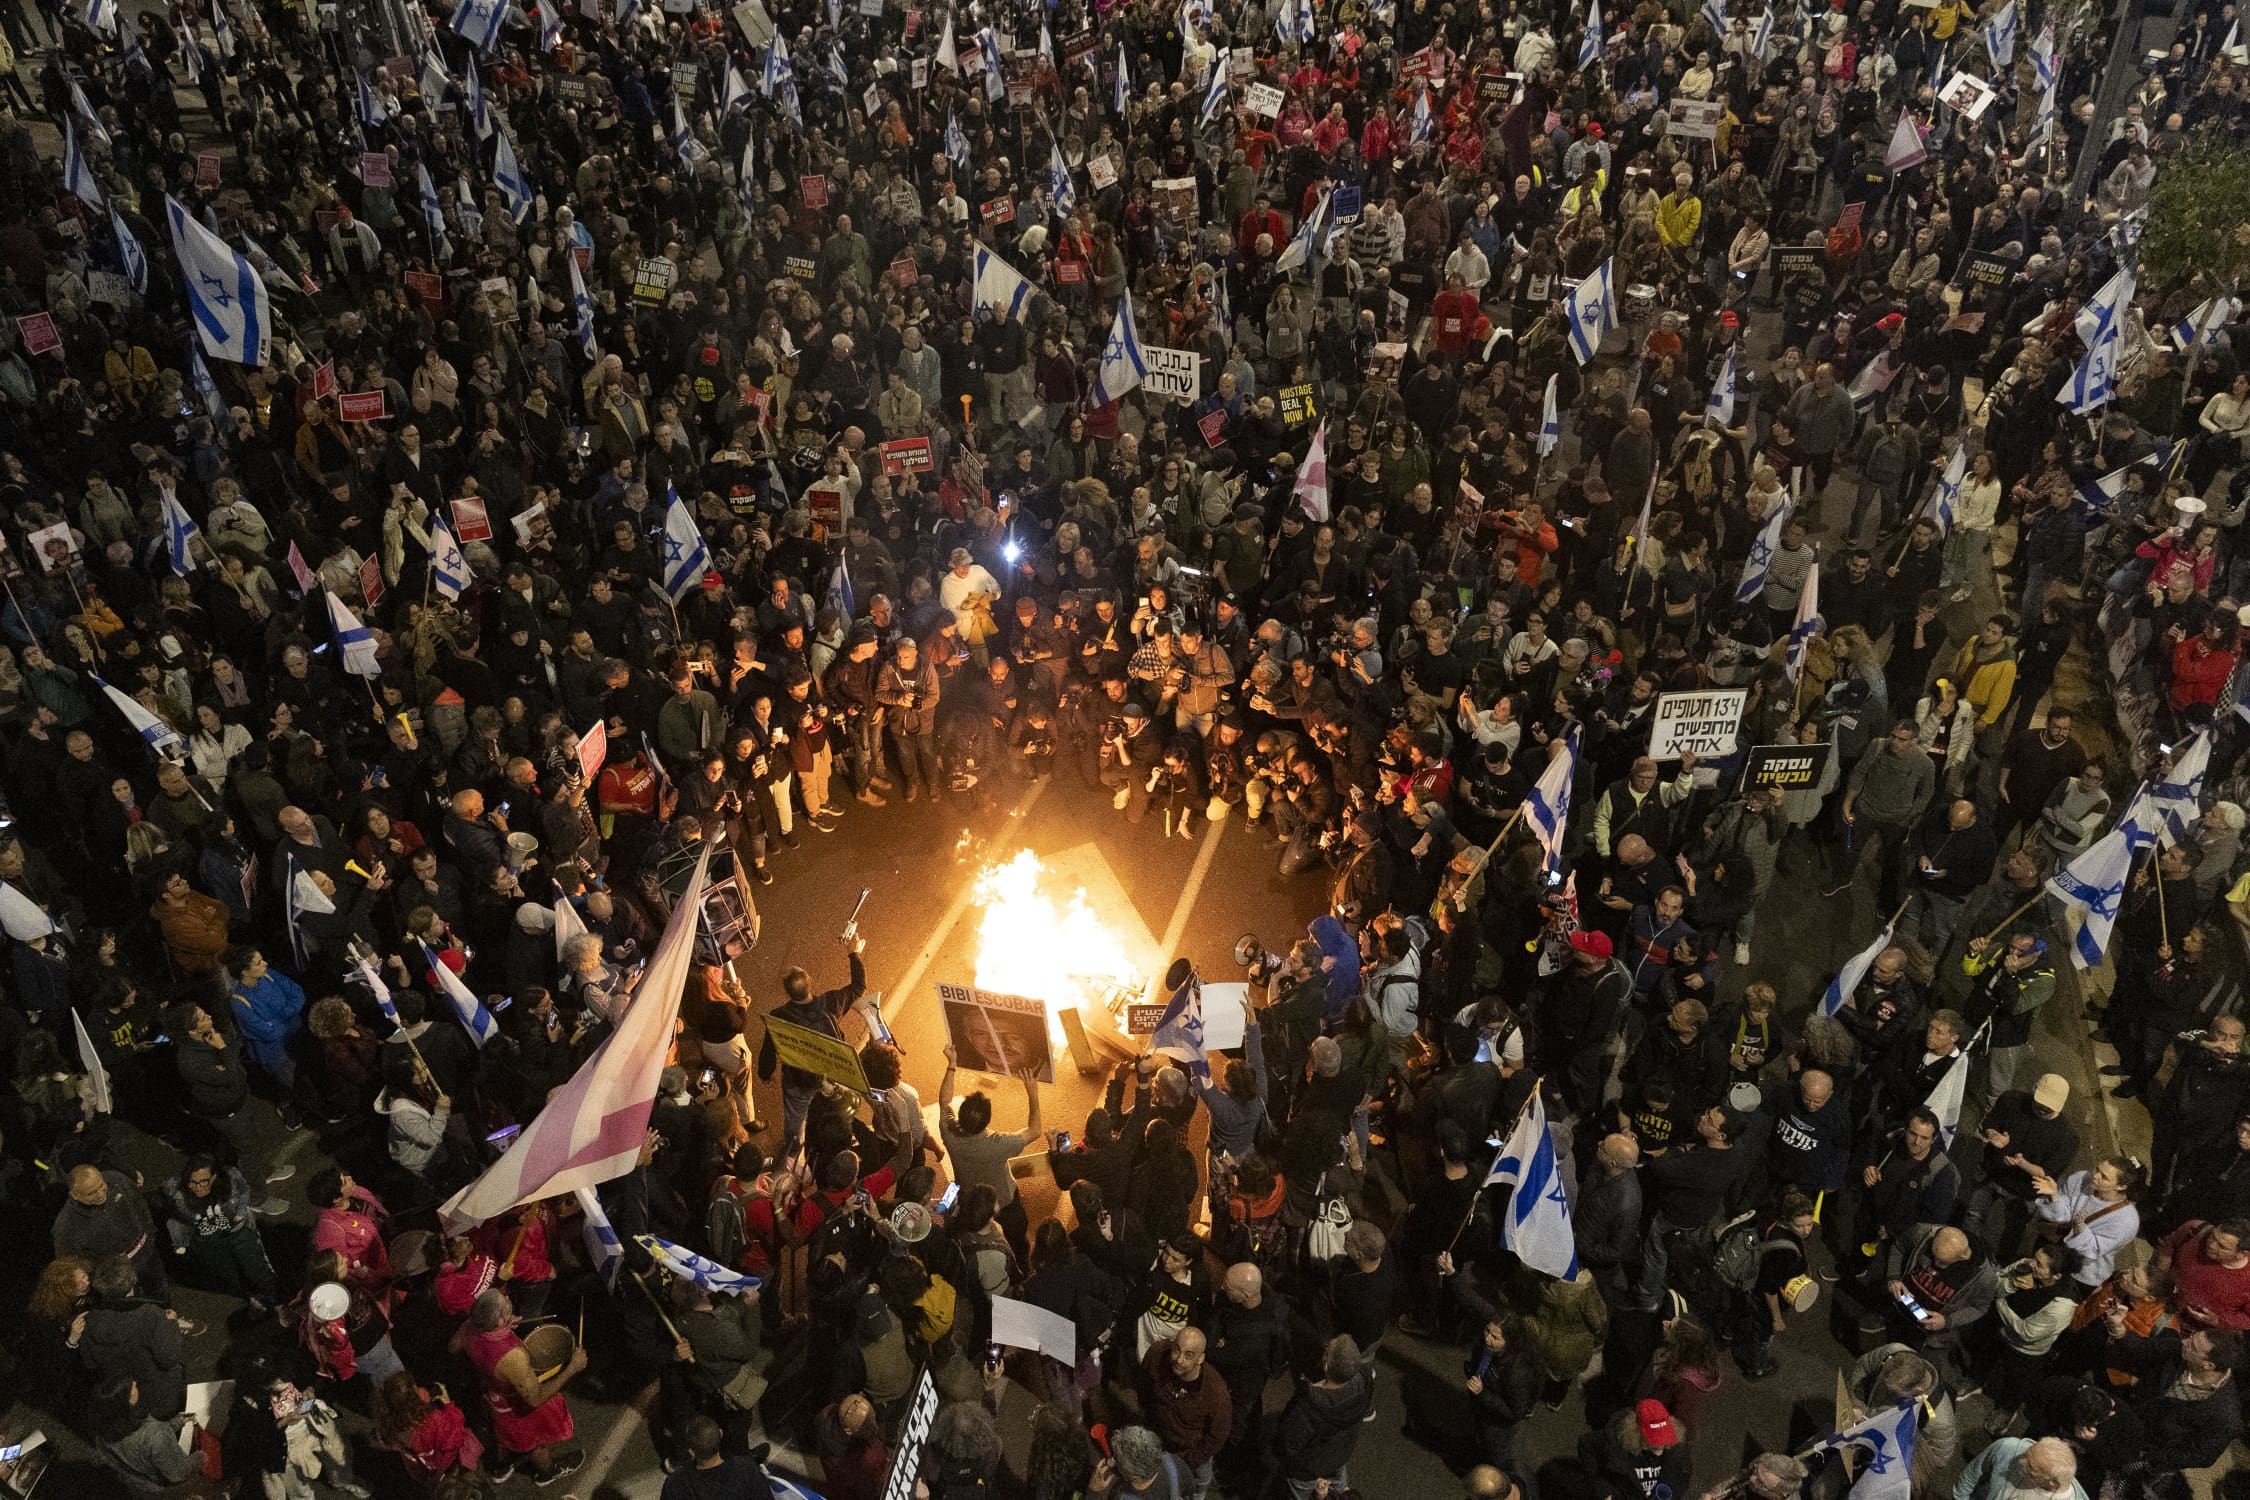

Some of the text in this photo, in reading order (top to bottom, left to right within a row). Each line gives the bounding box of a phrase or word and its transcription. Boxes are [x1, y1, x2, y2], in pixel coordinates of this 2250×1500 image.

[673, 62, 698, 75] LEAVING
[672, 70, 697, 85] NO ONE
[1484, 82, 1510, 92] עסקה
[638, 259, 671, 276] LEAVING
[785, 256, 815, 269] עסקה
[1971, 259, 2007, 275] עסקה
[636, 270, 668, 289] NO ONE
[1145, 349, 1192, 371] נתניהו
[1279, 383, 1314, 399] HOSTAGE
[1281, 397, 1302, 411] DEAL
[1284, 409, 1304, 424] NOW
[1661, 697, 1740, 720] 134 חטופים
[1674, 719, 1736, 737] מחפשים
[1665, 737, 1722, 755] אחראי
[1763, 757, 1814, 773] עסקה
[1755, 769, 1813, 784] עכשיו!
[941, 985, 971, 1003] BIBI
[974, 989, 1044, 1014] ESCOBAR
